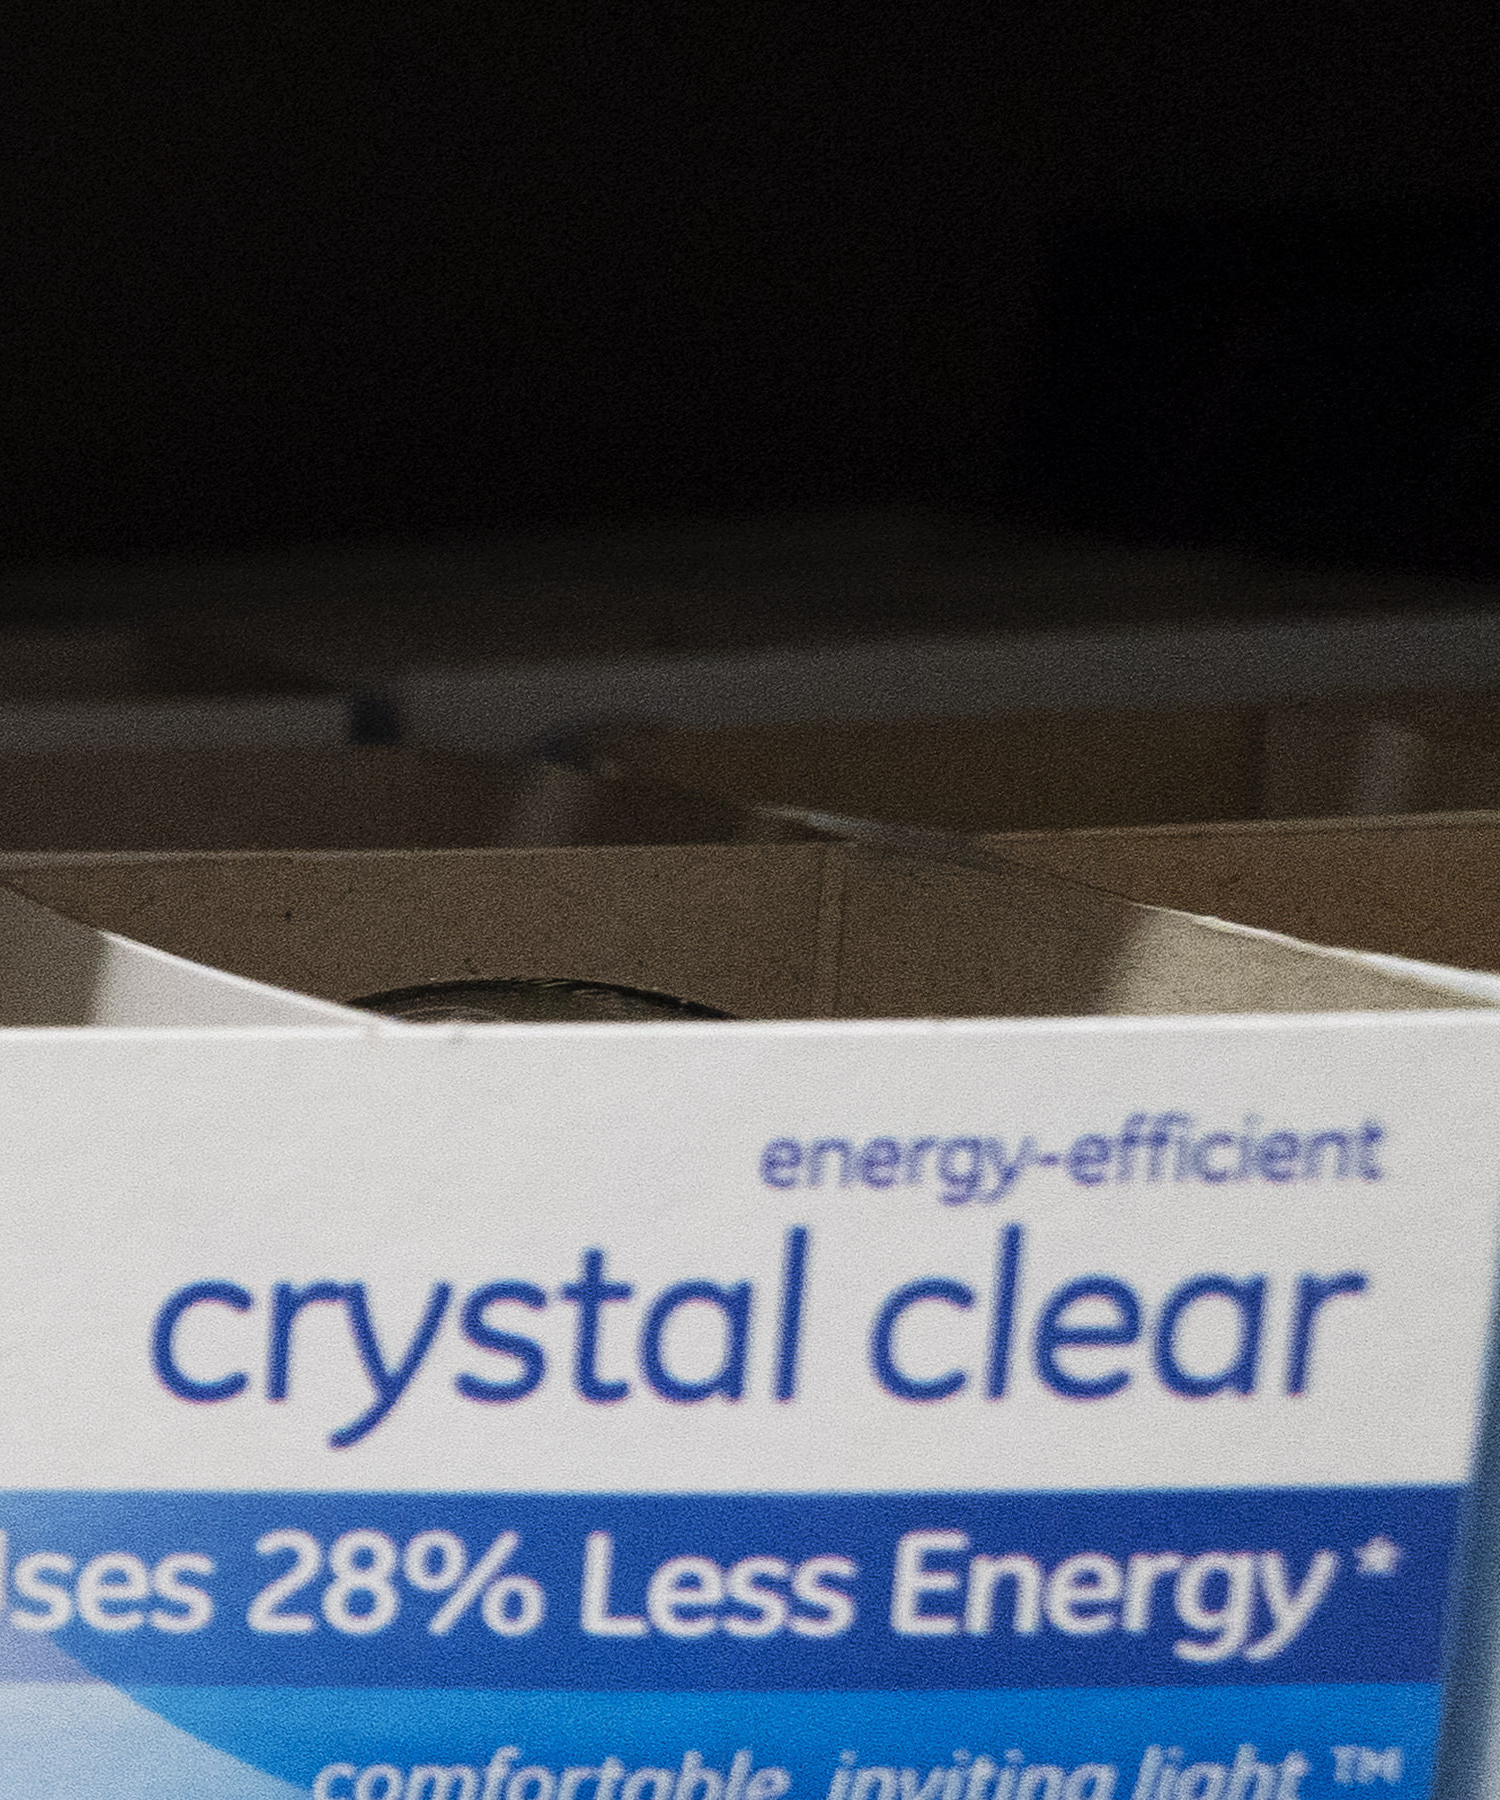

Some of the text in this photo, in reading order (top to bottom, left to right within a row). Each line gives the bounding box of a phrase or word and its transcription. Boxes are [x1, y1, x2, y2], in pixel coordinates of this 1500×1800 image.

[760, 1112, 1386, 1206] energy-efficient
[150, 1223, 1368, 1451] crystal clear
[247, 1528, 545, 1638] 28%
[582, 1531, 854, 1638] Less
